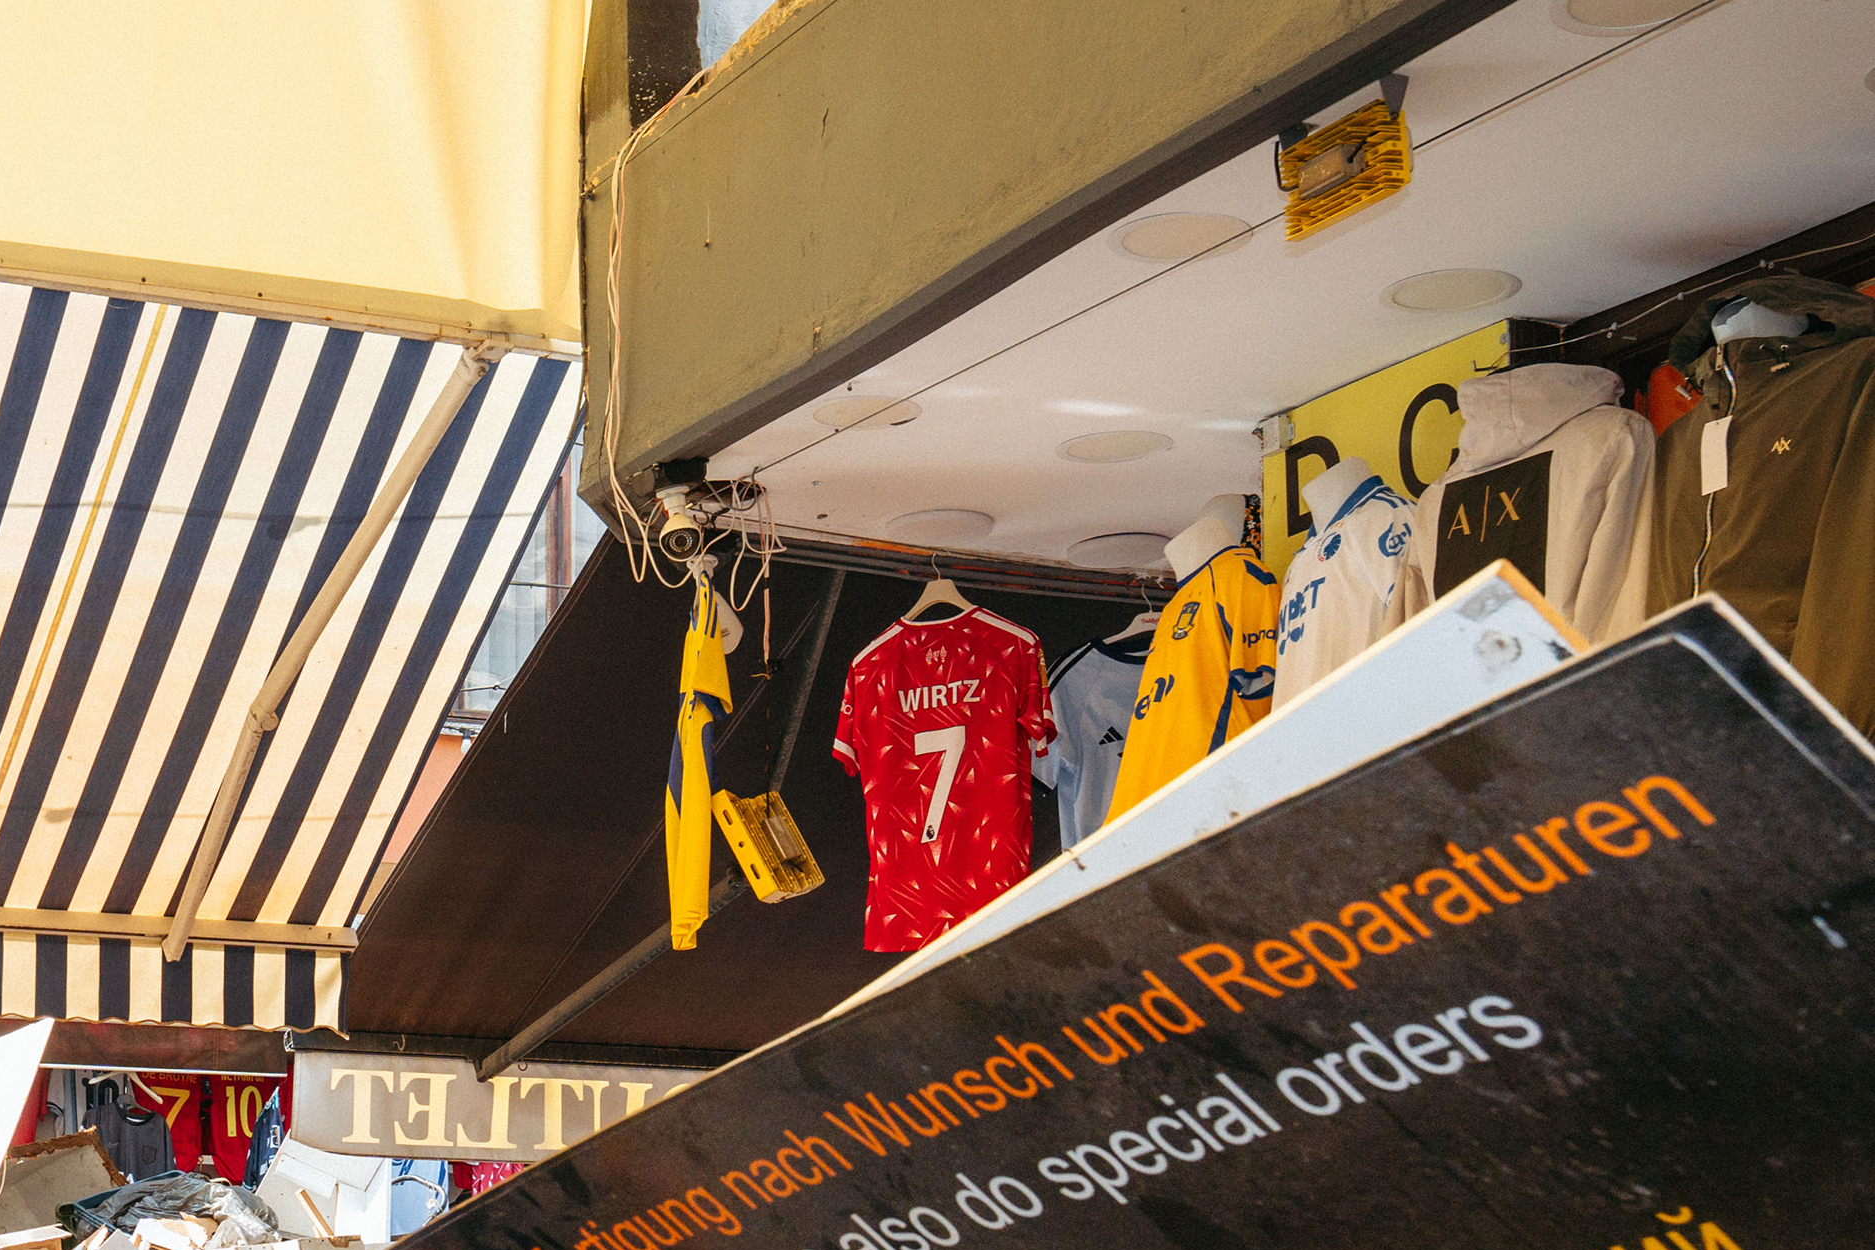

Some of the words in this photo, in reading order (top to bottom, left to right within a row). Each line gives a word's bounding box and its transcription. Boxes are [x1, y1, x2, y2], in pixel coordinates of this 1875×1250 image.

[898, 678, 981, 713] WIRTZ
[913, 724, 967, 844] 7
[719, 1128, 854, 1211] nach
[822, 1034, 1076, 1158] Wunsch
[1061, 969, 1207, 1067] und
[1178, 773, 1717, 1014] Reparaturen
[225, 1085, 263, 1138] 10
[955, 1172, 1044, 1231] do
[1037, 1072, 1282, 1206] special
[1276, 993, 1544, 1117] orders
